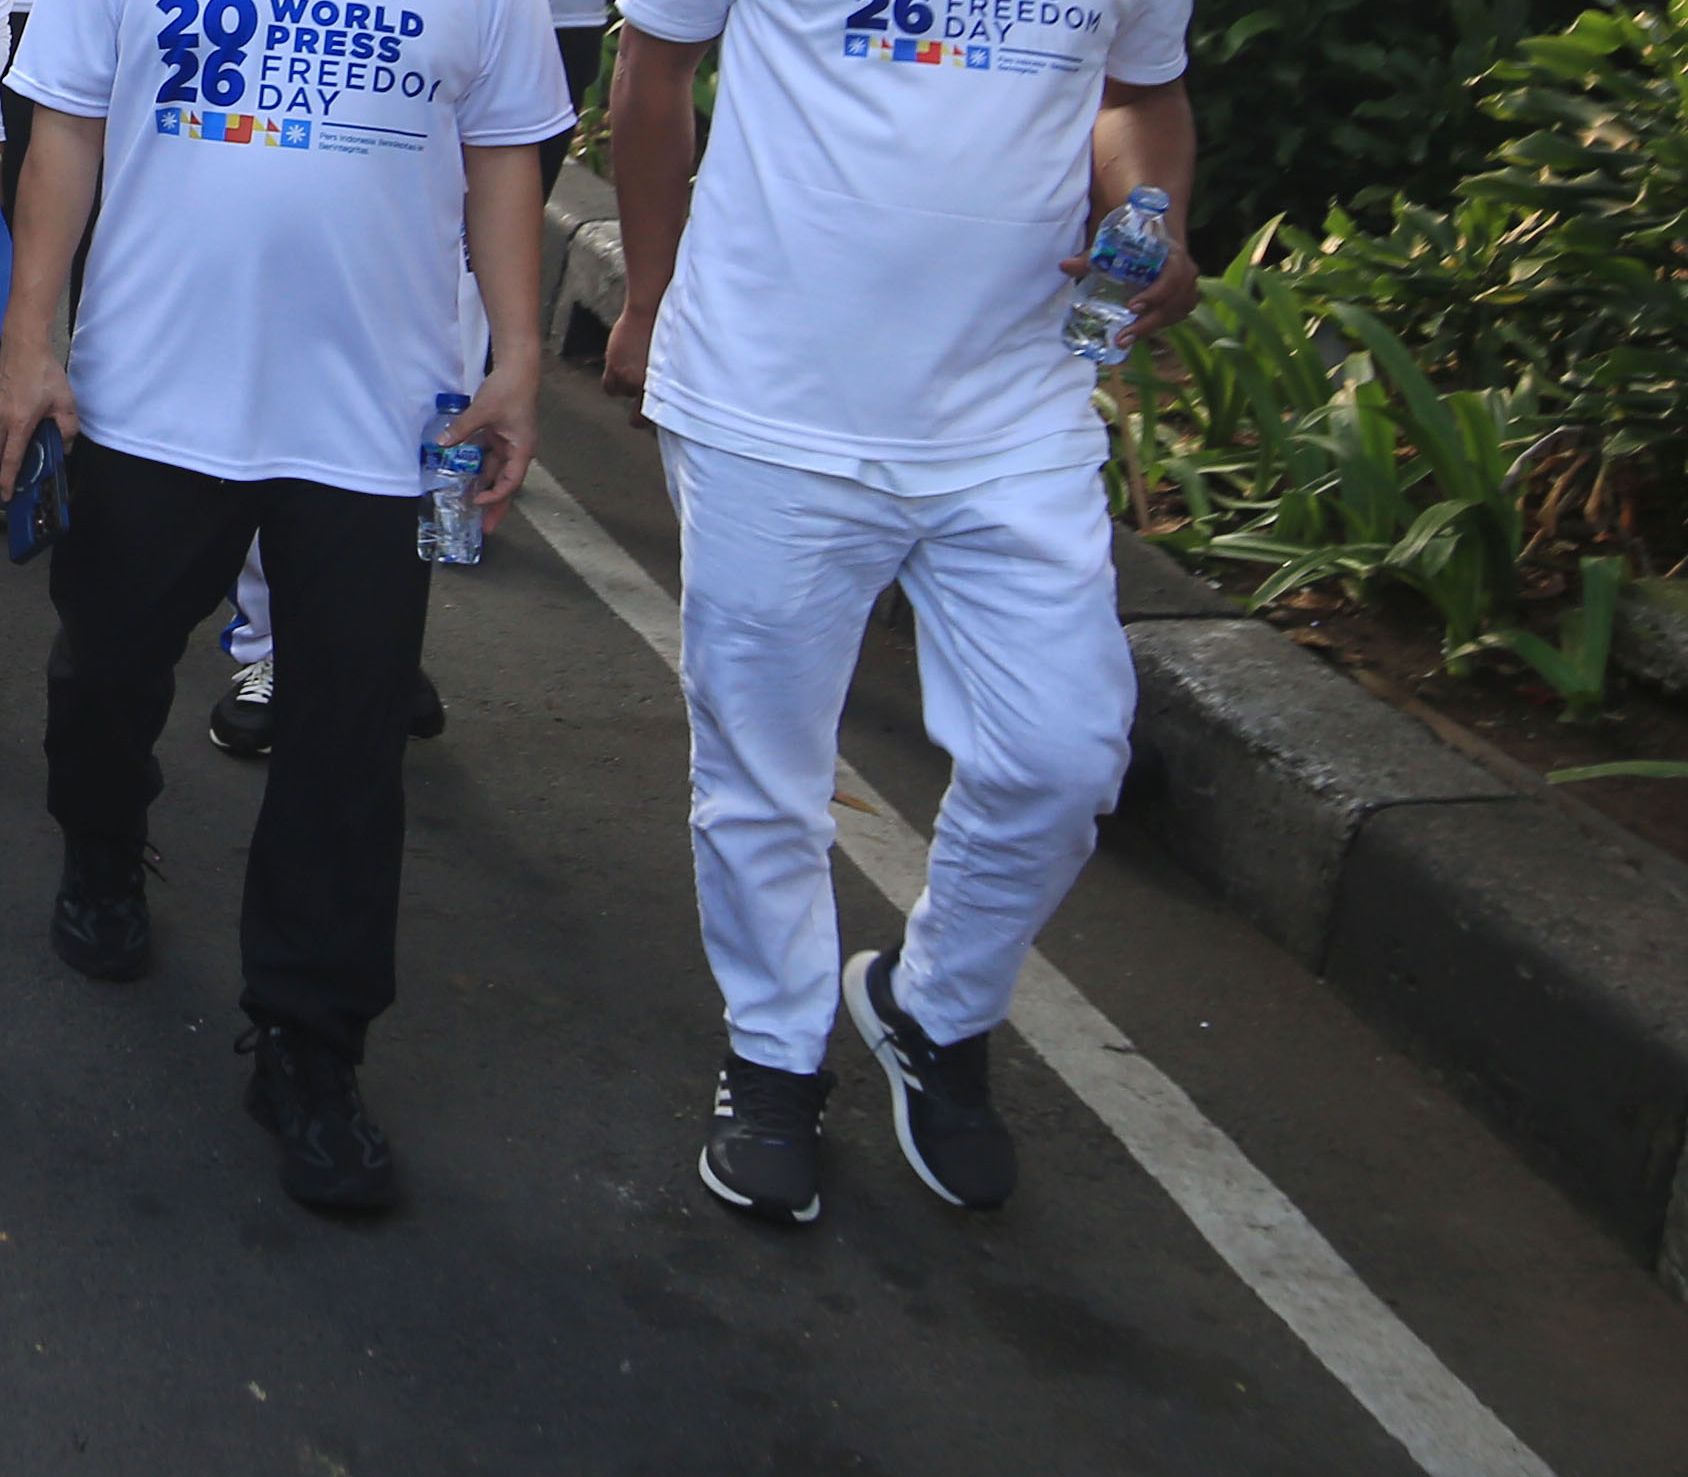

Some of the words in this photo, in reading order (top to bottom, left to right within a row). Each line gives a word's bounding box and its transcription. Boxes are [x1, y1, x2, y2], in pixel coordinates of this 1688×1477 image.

[265, 24, 401, 64] PRESS
[943, 16, 1014, 44] DAY
[155, 45, 247, 107] 26
[257, 84, 341, 117] DAY
